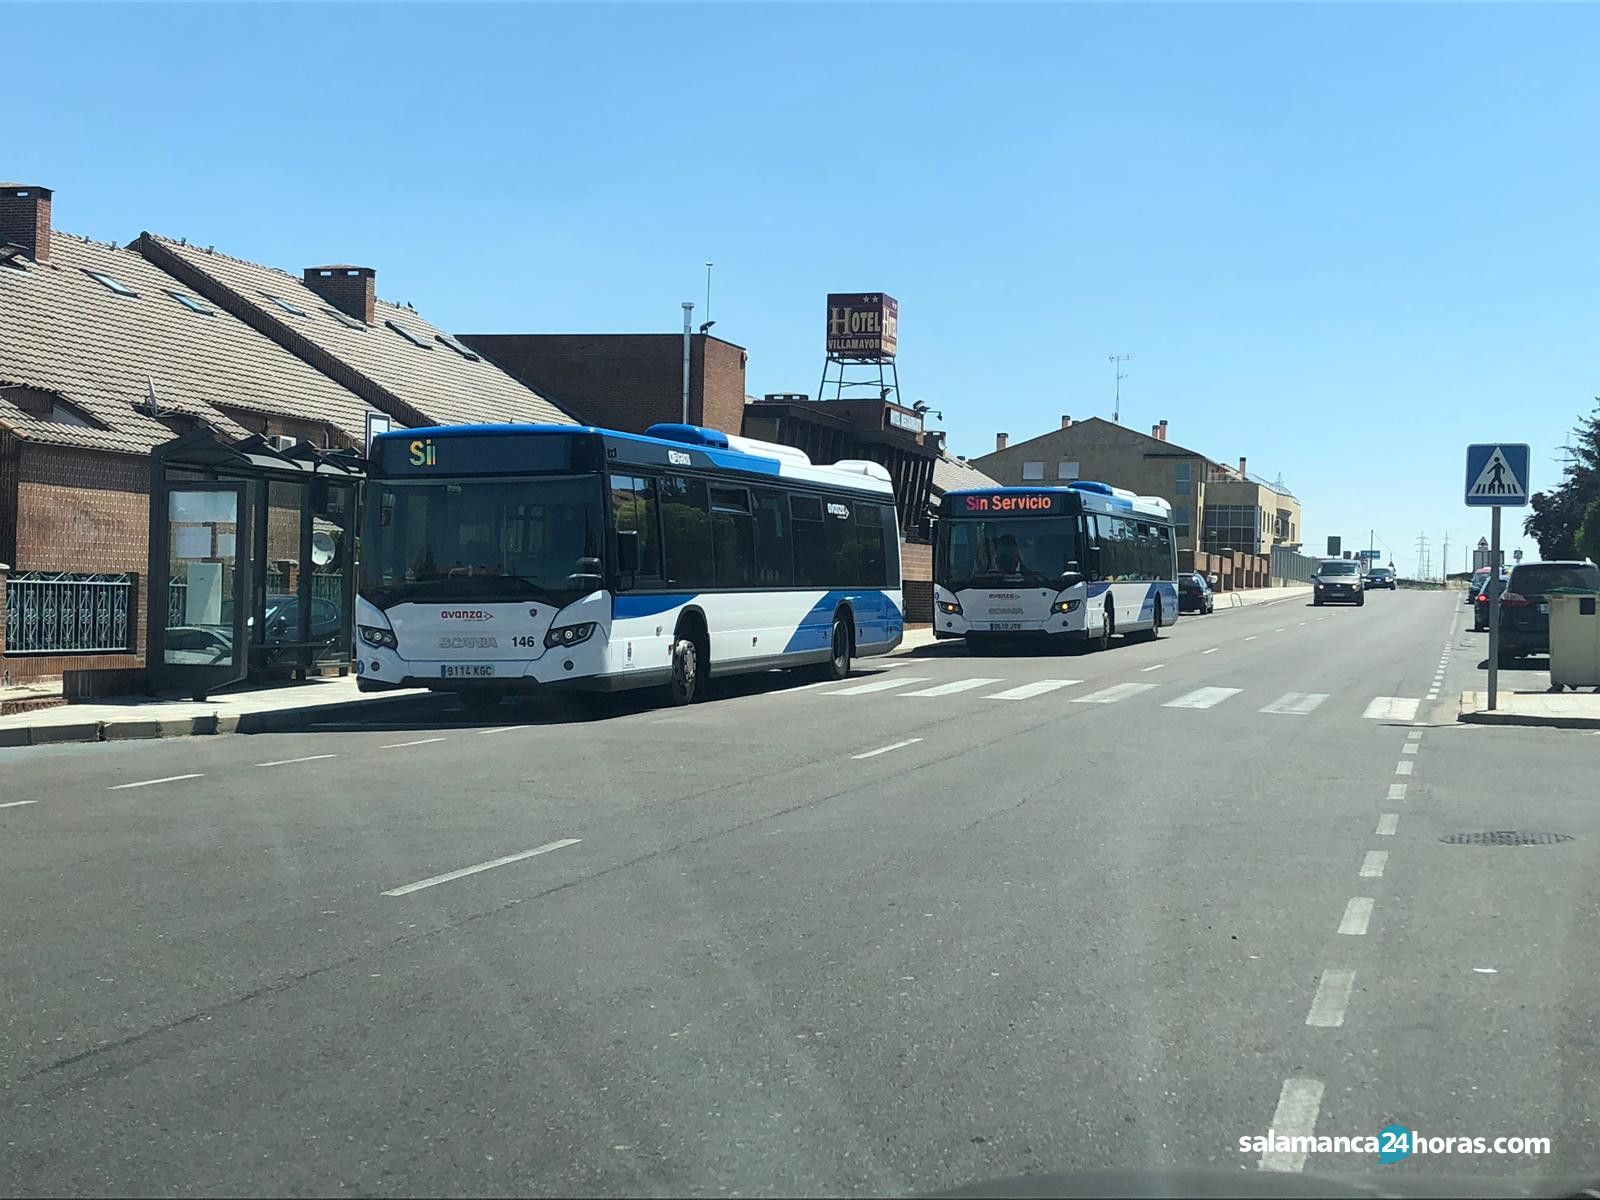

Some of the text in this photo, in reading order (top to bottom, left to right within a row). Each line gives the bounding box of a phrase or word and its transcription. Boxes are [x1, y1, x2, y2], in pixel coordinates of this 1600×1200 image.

[829, 307, 880, 335] HOTEL
[828, 339, 880, 349] VILLAMAYOR
[966, 495, 1051, 510] Sin Servicio
[441, 610, 483, 619] avanza
[511, 636, 535, 647] 146
[447, 666, 471, 676] 9114
